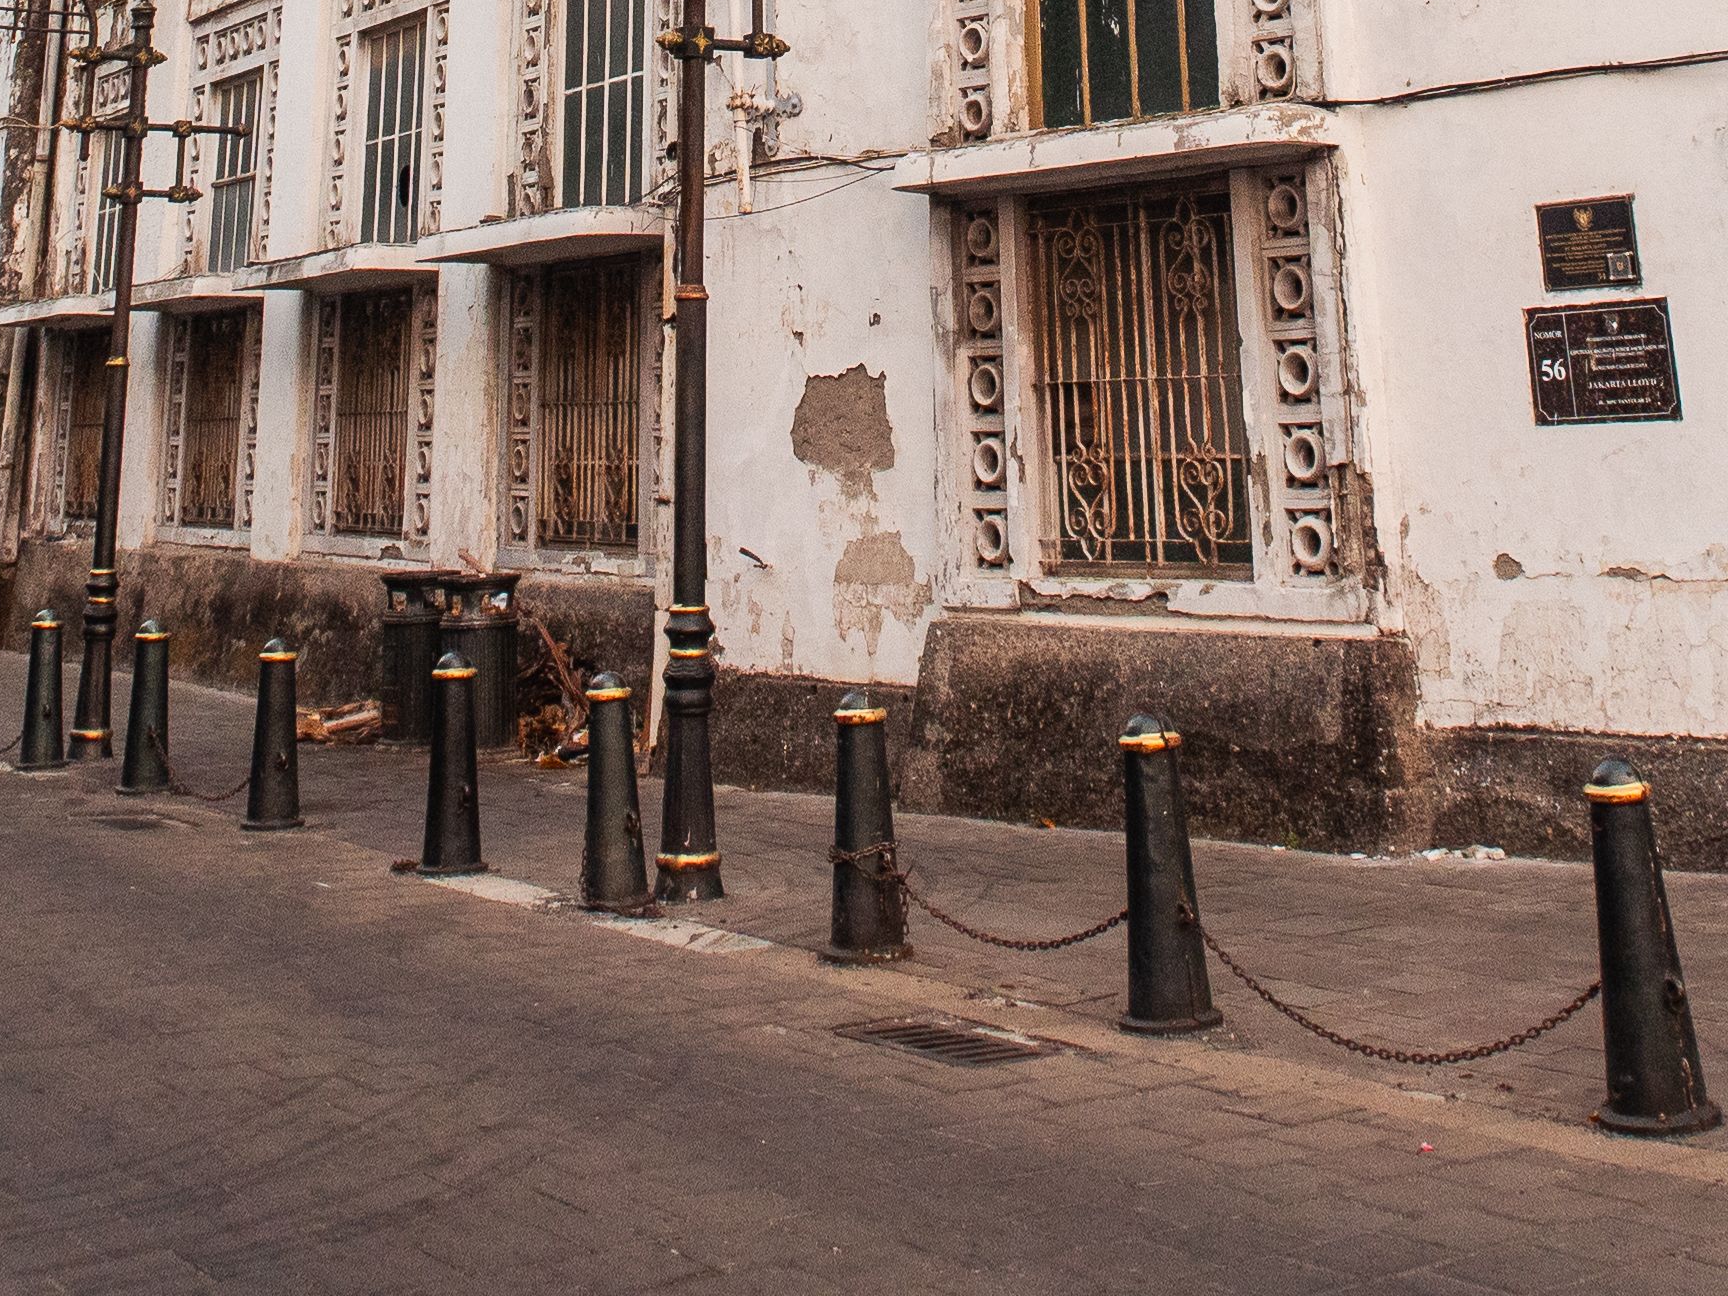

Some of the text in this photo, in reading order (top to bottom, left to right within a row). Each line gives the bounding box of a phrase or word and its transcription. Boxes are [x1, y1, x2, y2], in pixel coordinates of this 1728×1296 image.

[1534, 330, 1562, 339] NOMOR
[1541, 358, 1566, 382] 56
[1588, 379, 1626, 389] JAKARTA
